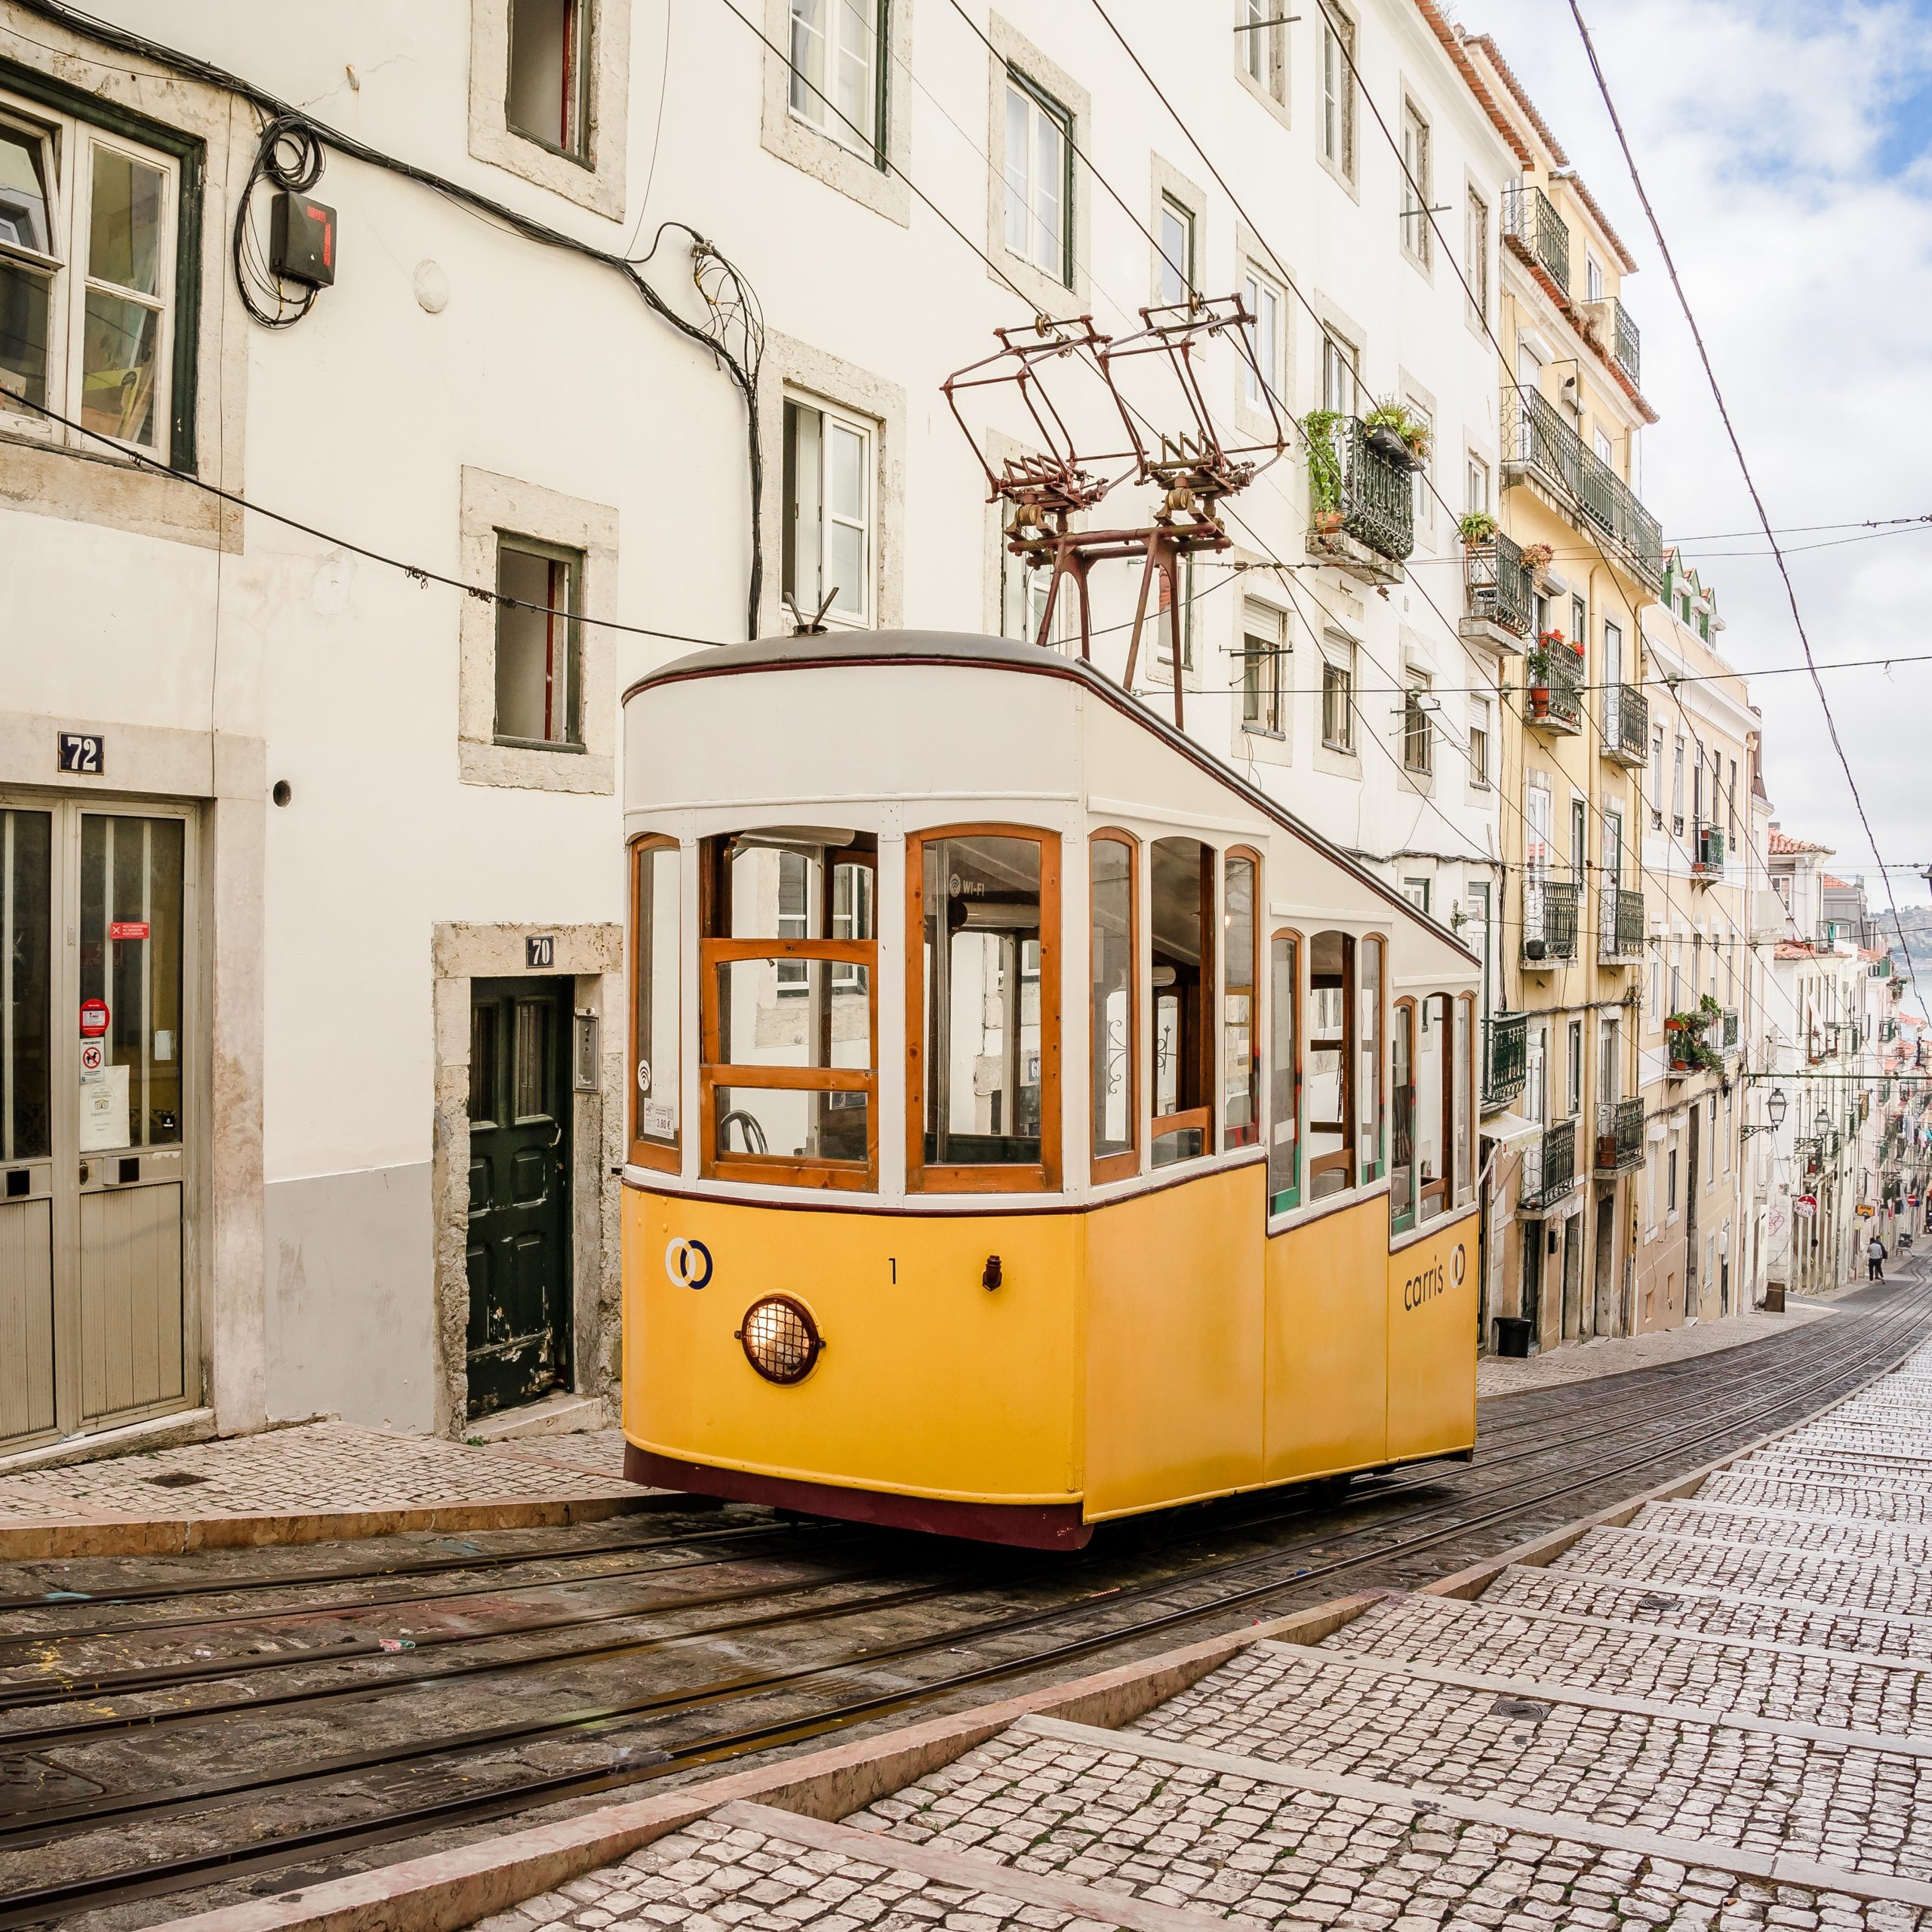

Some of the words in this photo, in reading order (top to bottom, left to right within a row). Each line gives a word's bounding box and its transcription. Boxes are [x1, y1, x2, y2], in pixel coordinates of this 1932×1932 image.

[68, 737, 97, 771] 72
[963, 880, 985, 897] WI-FI
[533, 940, 550, 964] 70
[888, 1258, 896, 1284] 1
[1404, 1254, 1443, 1312] carris
